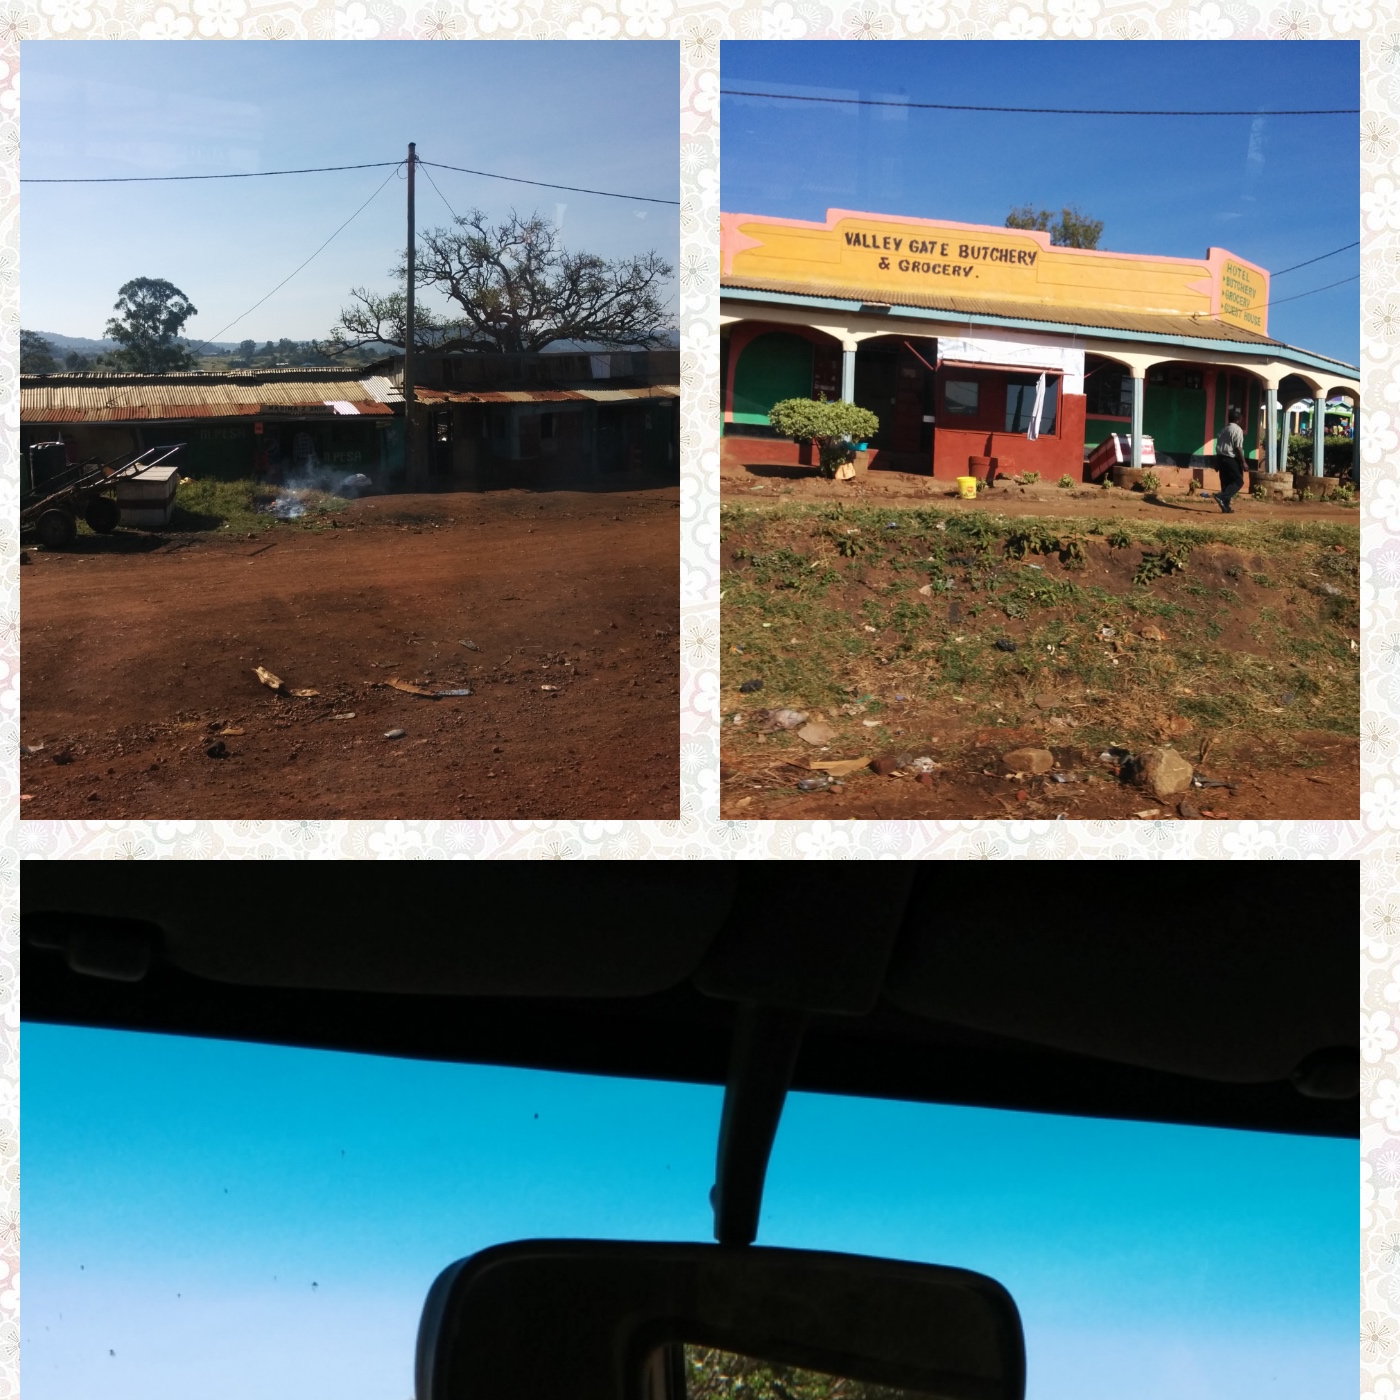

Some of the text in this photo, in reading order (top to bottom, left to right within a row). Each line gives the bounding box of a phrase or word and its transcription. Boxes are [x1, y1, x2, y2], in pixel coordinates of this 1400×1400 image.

[844, 231, 1038, 267] VALLEY GATE BUTCHERY
[878, 256, 890, 270] &
[1227, 262, 1250, 283] HOTEL
[1225, 276, 1257, 299] BUTCHERY
[1225, 289, 1251, 308] GROCERY
[1224, 303, 1261, 327] GUEST HOUSE
